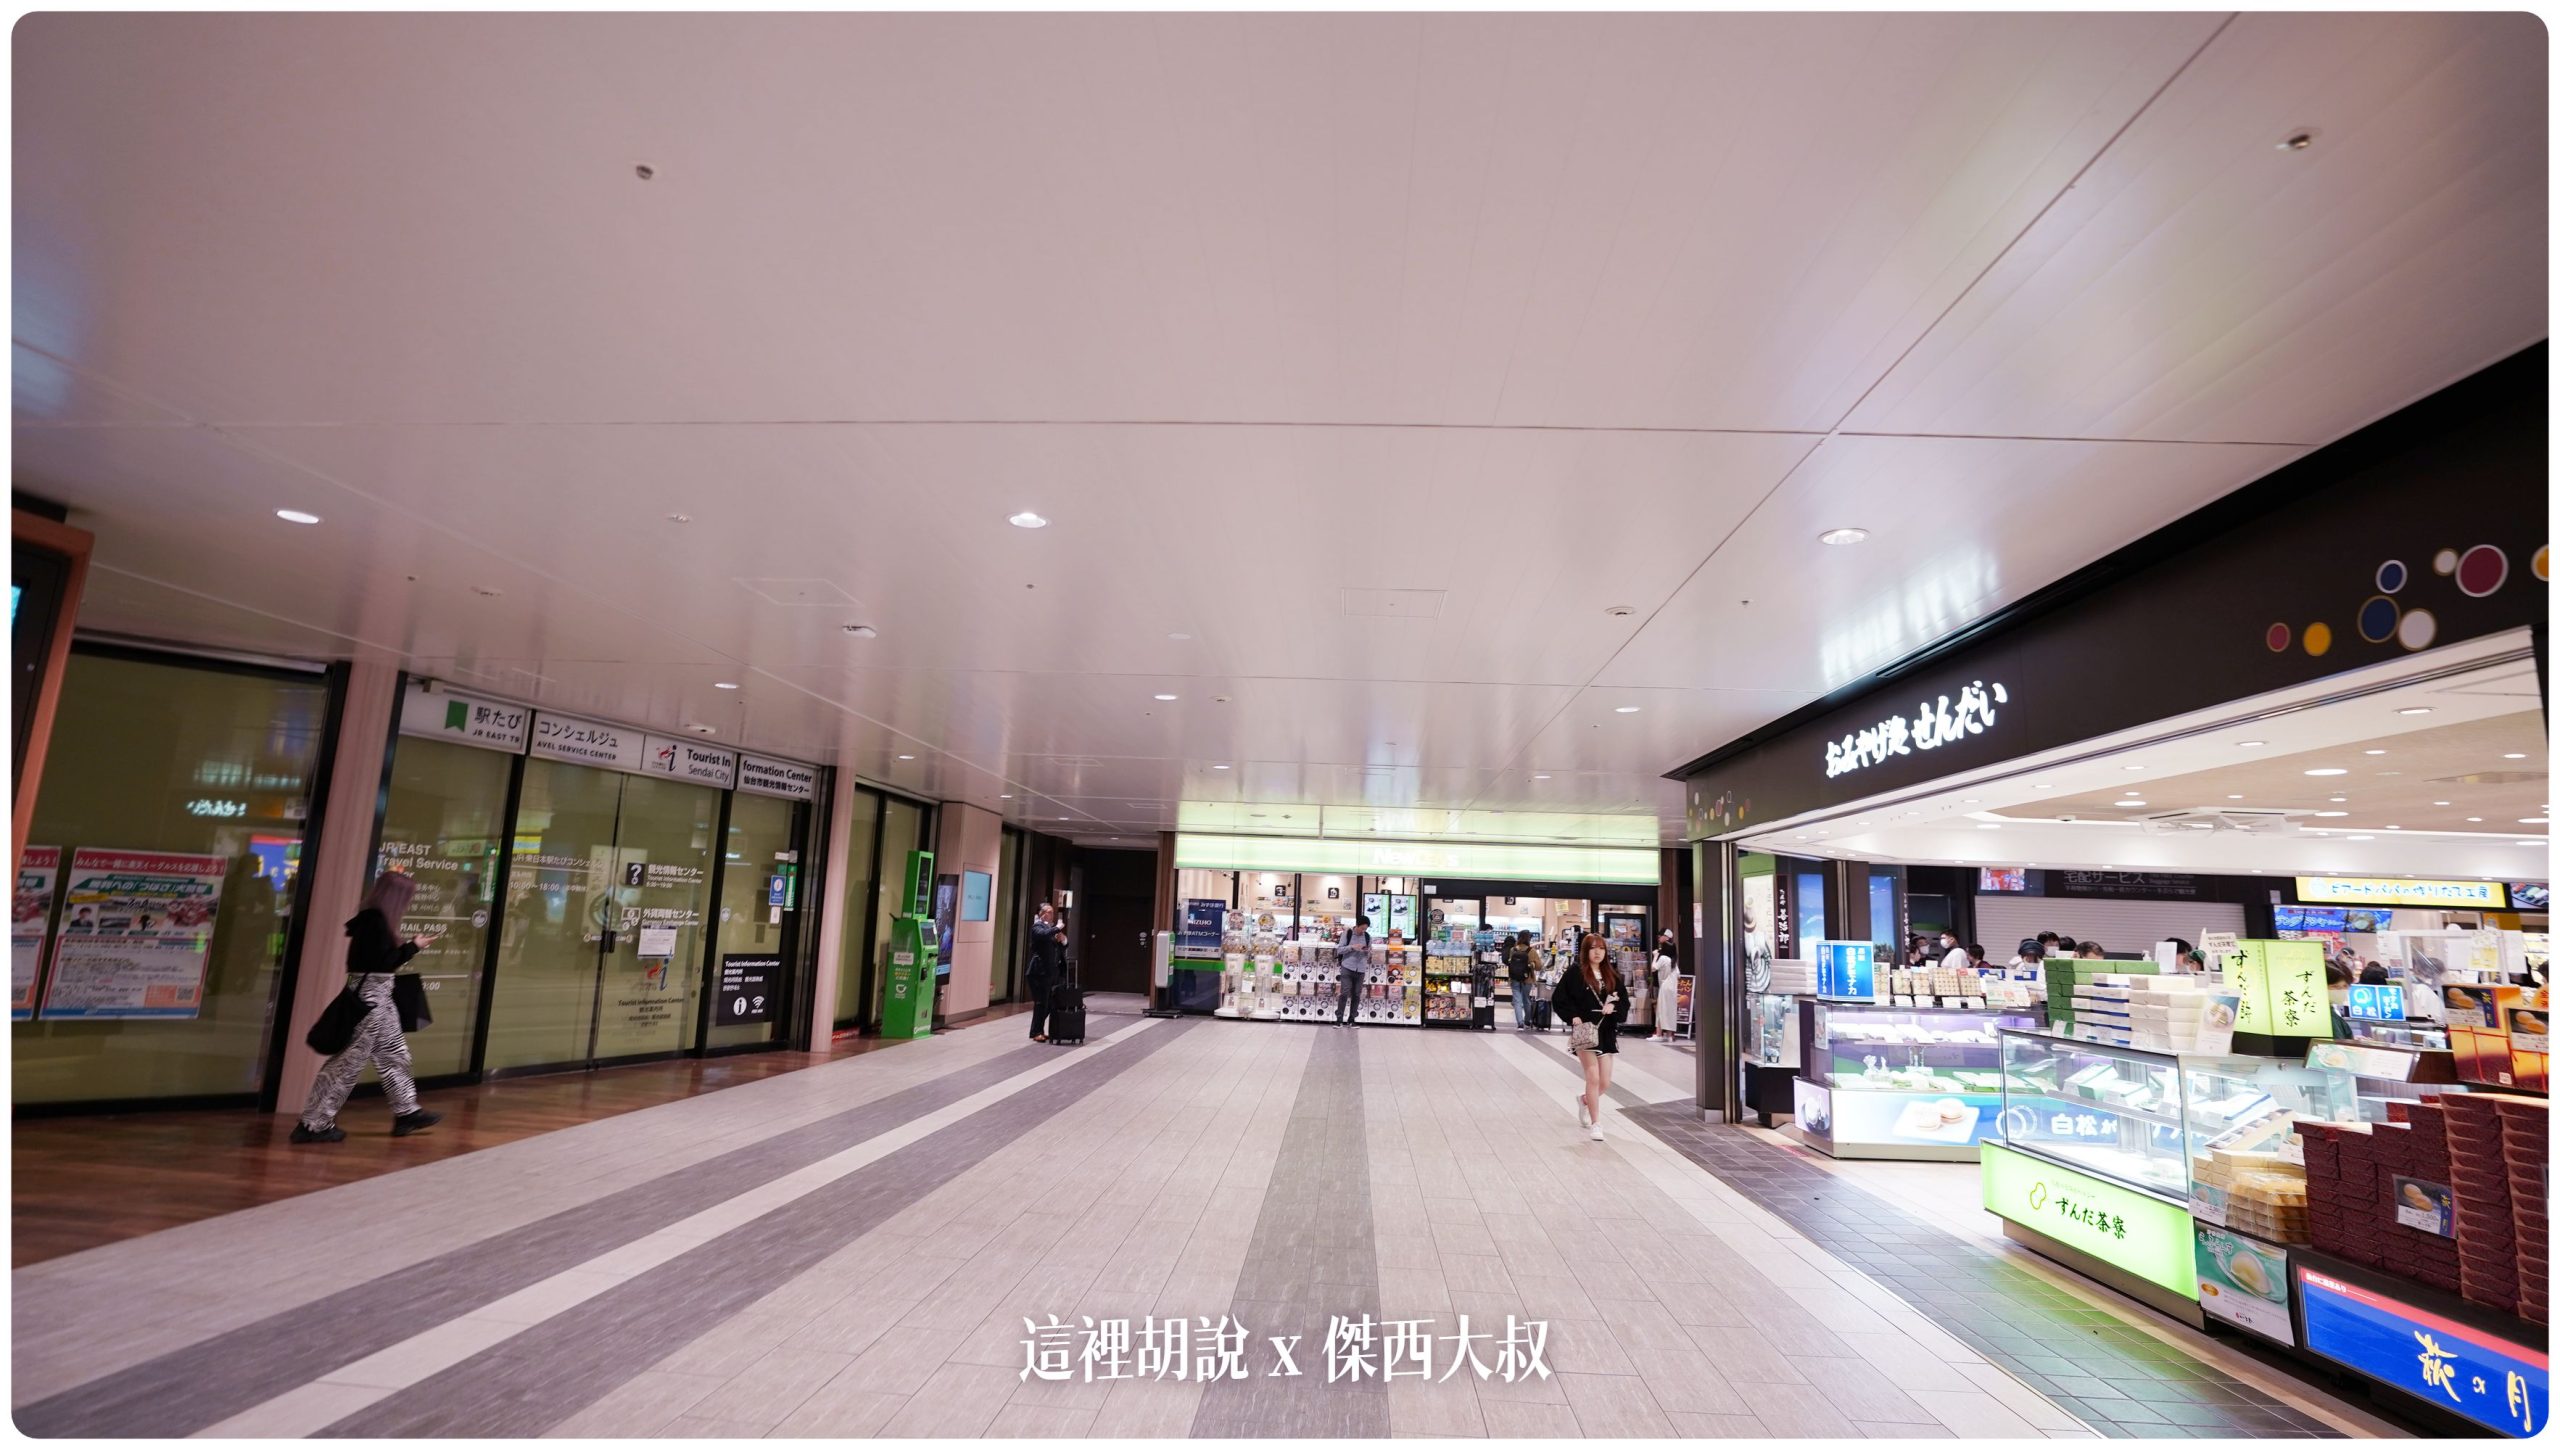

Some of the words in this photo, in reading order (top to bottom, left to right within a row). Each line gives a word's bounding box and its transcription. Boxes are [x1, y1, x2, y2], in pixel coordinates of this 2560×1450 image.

[474, 705, 523, 730] 駅たび
[1911, 680, 2008, 750] せんだい
[472, 728, 484, 737] JR
[486, 731, 506, 741] EAST
[509, 734, 521, 744] TR
[538, 720, 619, 748] コンシェルジュ
[536, 741, 556, 750] AVEL
[557, 744, 588, 756] SERVICE
[589, 749, 617, 761] CENTER
[686, 748, 720, 766] Tourist
[721, 756, 731, 768] In
[688, 764, 714, 778] Sendai
[714, 768, 730, 783] City
[743, 760, 785, 777] formation
[785, 768, 813, 784] Center
[398, 843, 432, 856] EAST
[376, 855, 414, 868] Travel
[415, 858, 459, 871] Service
[400, 923, 421, 932] RAIL
[423, 923, 447, 933] PASS
[2296, 970, 2316, 1014] ずんだ
[2283, 990, 2300, 1027] 茶寮
[2055, 1197, 2127, 1239] ずんだ茶寮
